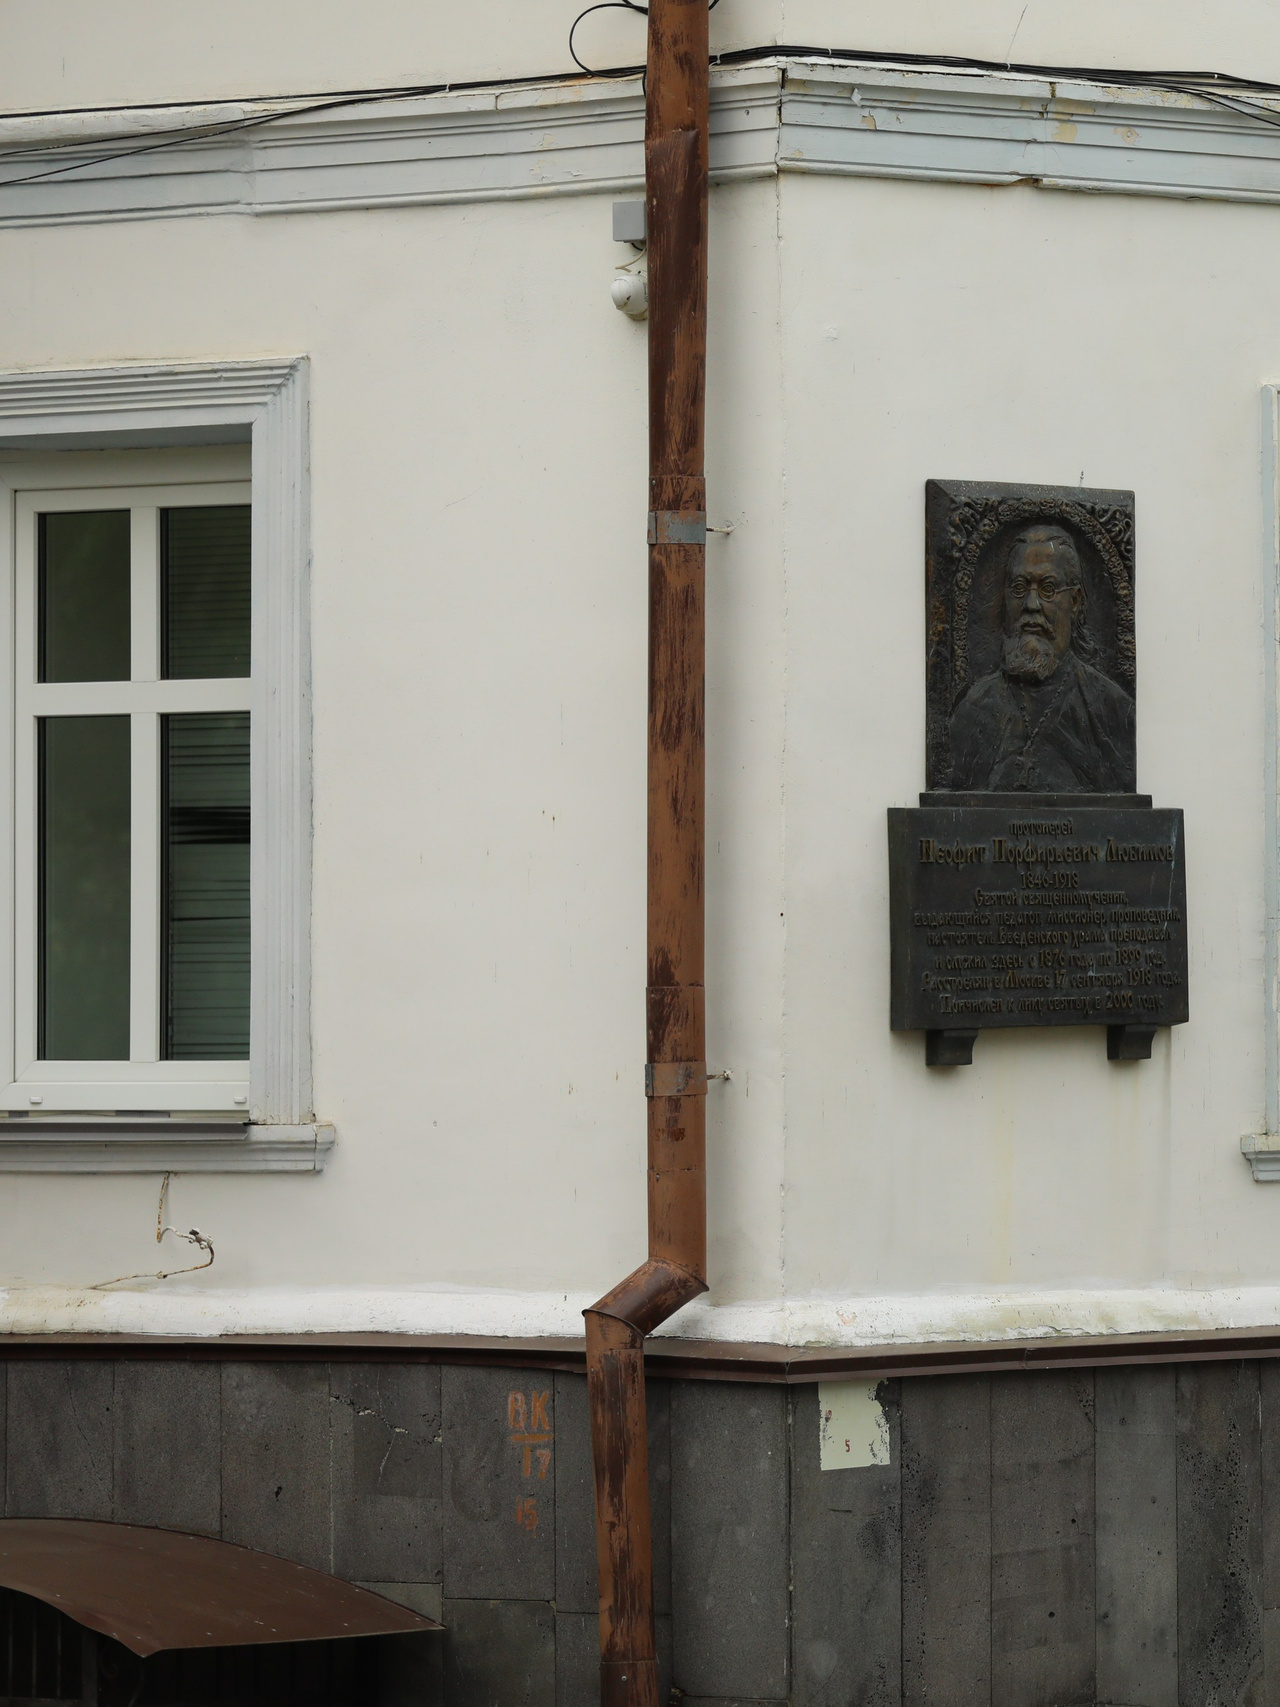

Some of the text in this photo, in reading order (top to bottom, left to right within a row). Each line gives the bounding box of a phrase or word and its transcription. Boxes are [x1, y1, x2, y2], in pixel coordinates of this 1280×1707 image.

[1009, 818, 1074, 839] протоиерей
[919, 837, 1173, 871] Неофит Порфирьевич Любимов
[1021, 871, 1078, 889] 1846-1918
[975, 888, 1017, 907] Святой
[914, 911, 992, 928] выдающийся
[991, 956, 1024, 970] здесь
[1038, 950, 1065, 967] 1876
[1003, 971, 1050, 988] Москве
[1054, 970, 1066, 985] 17
[1127, 969, 1152, 985] 1918
[845, 1439, 850, 1453] 5
